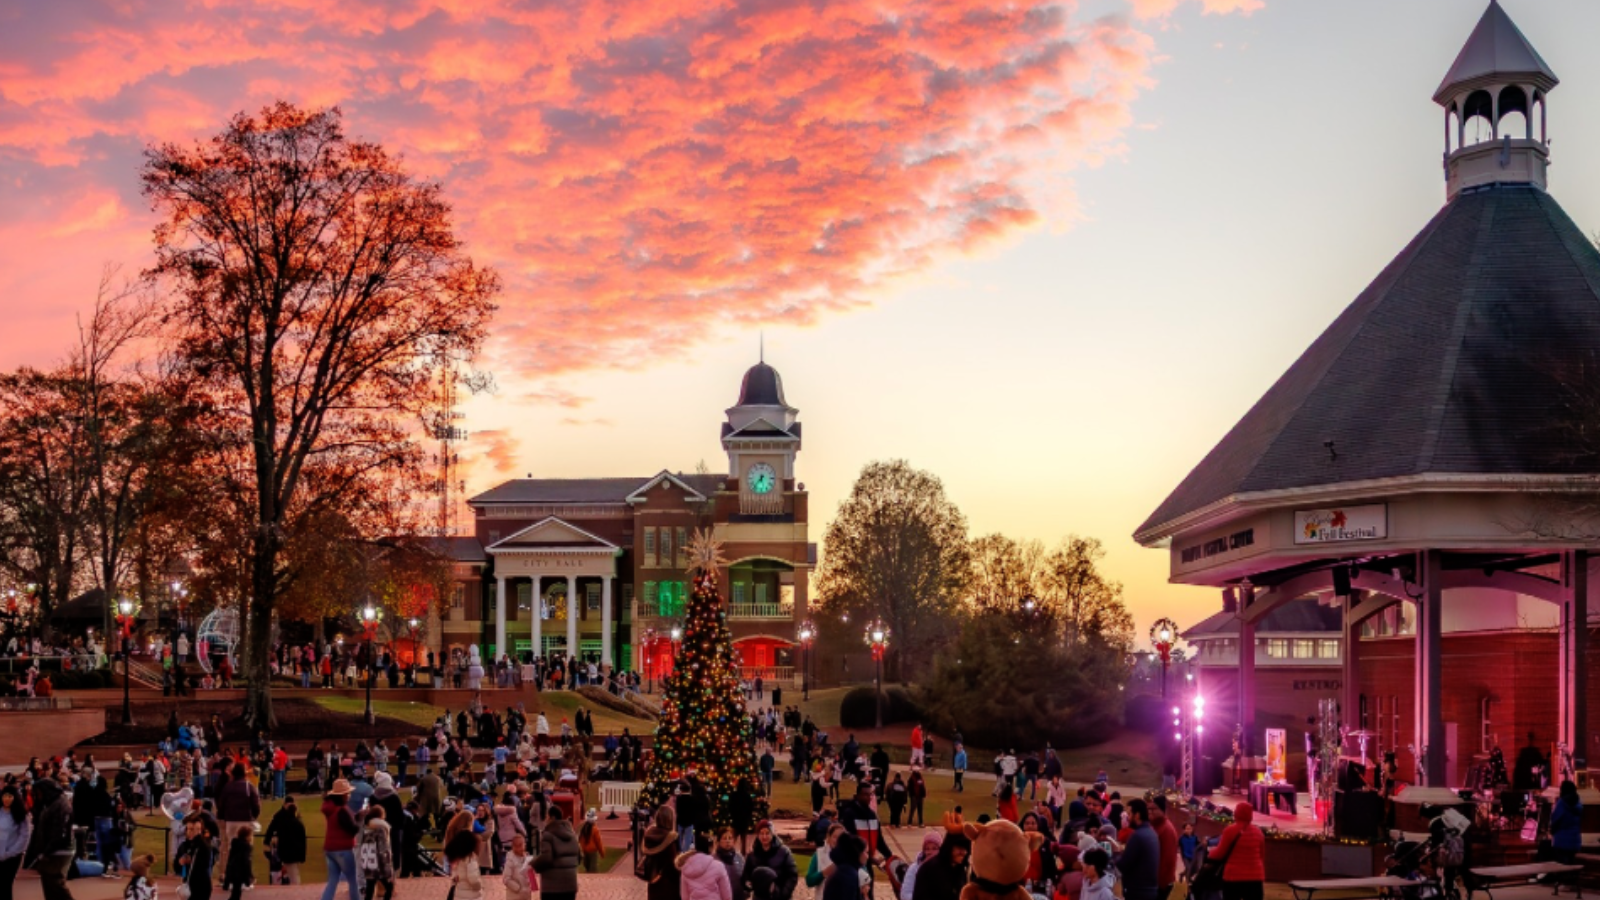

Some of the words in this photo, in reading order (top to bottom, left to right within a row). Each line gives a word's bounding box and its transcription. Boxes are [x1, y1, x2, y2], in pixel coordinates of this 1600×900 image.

[1338, 525, 1377, 539] Festival
[523, 559, 549, 567] CITY
[556, 559, 583, 567] HALL
